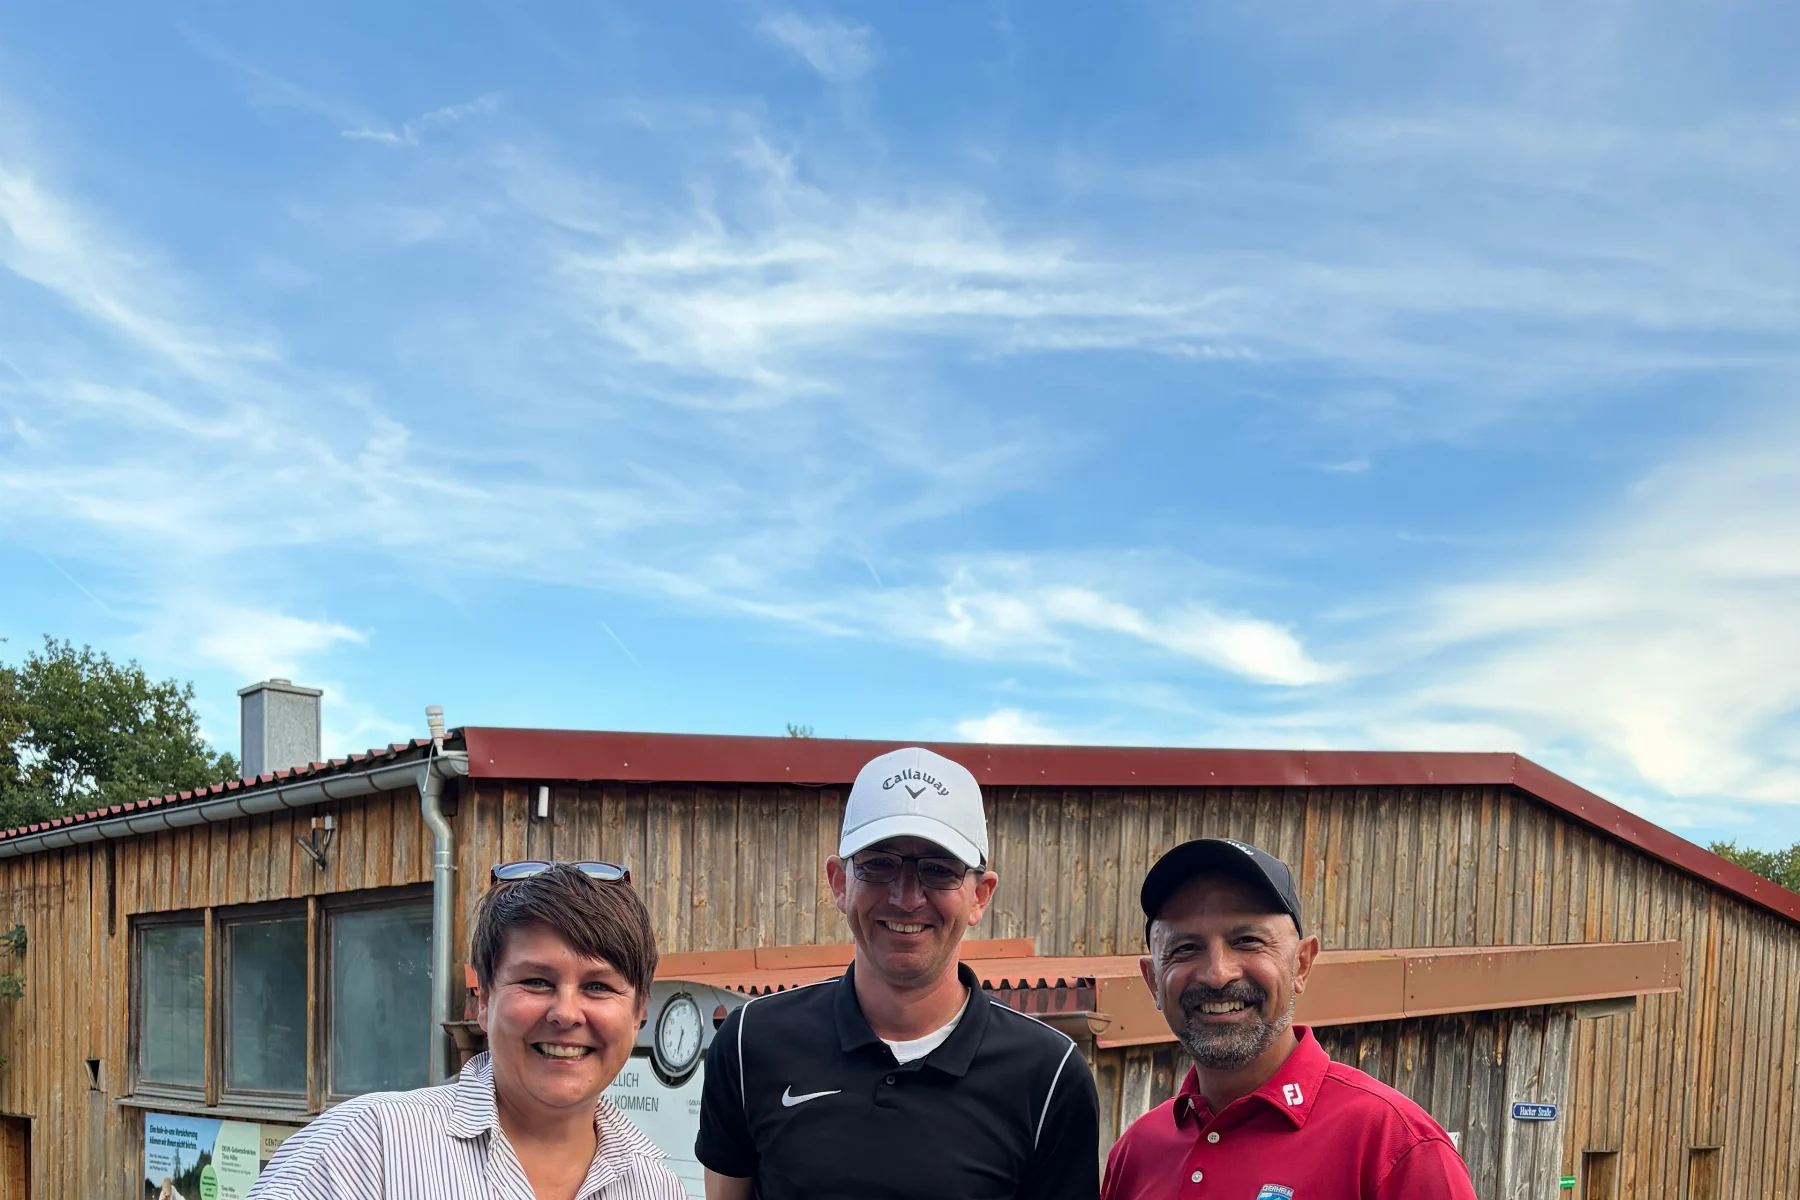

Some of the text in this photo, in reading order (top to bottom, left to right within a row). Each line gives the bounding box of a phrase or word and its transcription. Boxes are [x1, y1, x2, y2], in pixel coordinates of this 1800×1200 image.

[883, 768, 950, 796] Callaway
[611, 1072, 639, 1088] ZLICH
[1282, 1083, 1304, 1106] FJ
